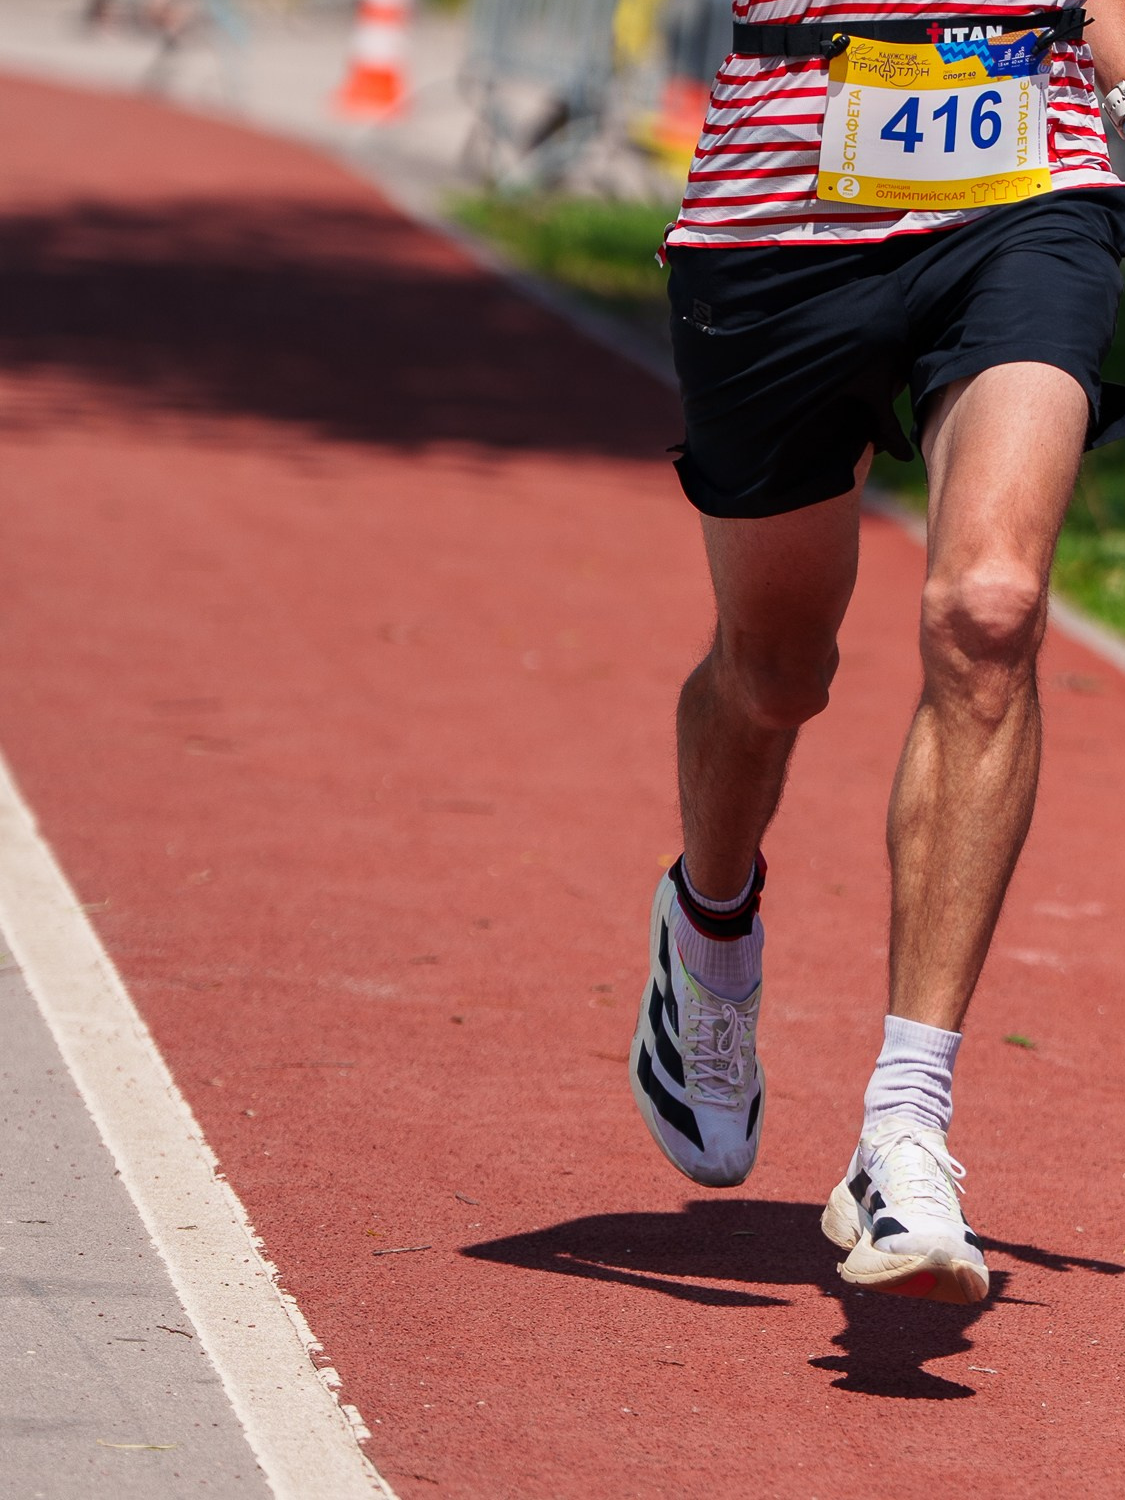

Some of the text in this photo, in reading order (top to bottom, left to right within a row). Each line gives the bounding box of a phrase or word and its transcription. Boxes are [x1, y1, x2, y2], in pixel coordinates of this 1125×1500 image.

[943, 72, 966, 80] СПОРТ
[842, 89, 862, 172] ЭСТАФЕТА
[880, 90, 1003, 154] 416
[1016, 81, 1029, 167] ЭСТАФЕТА
[842, 179, 854, 192] 2
[875, 189, 966, 201] ОЛИМПИЙСКАЯ
